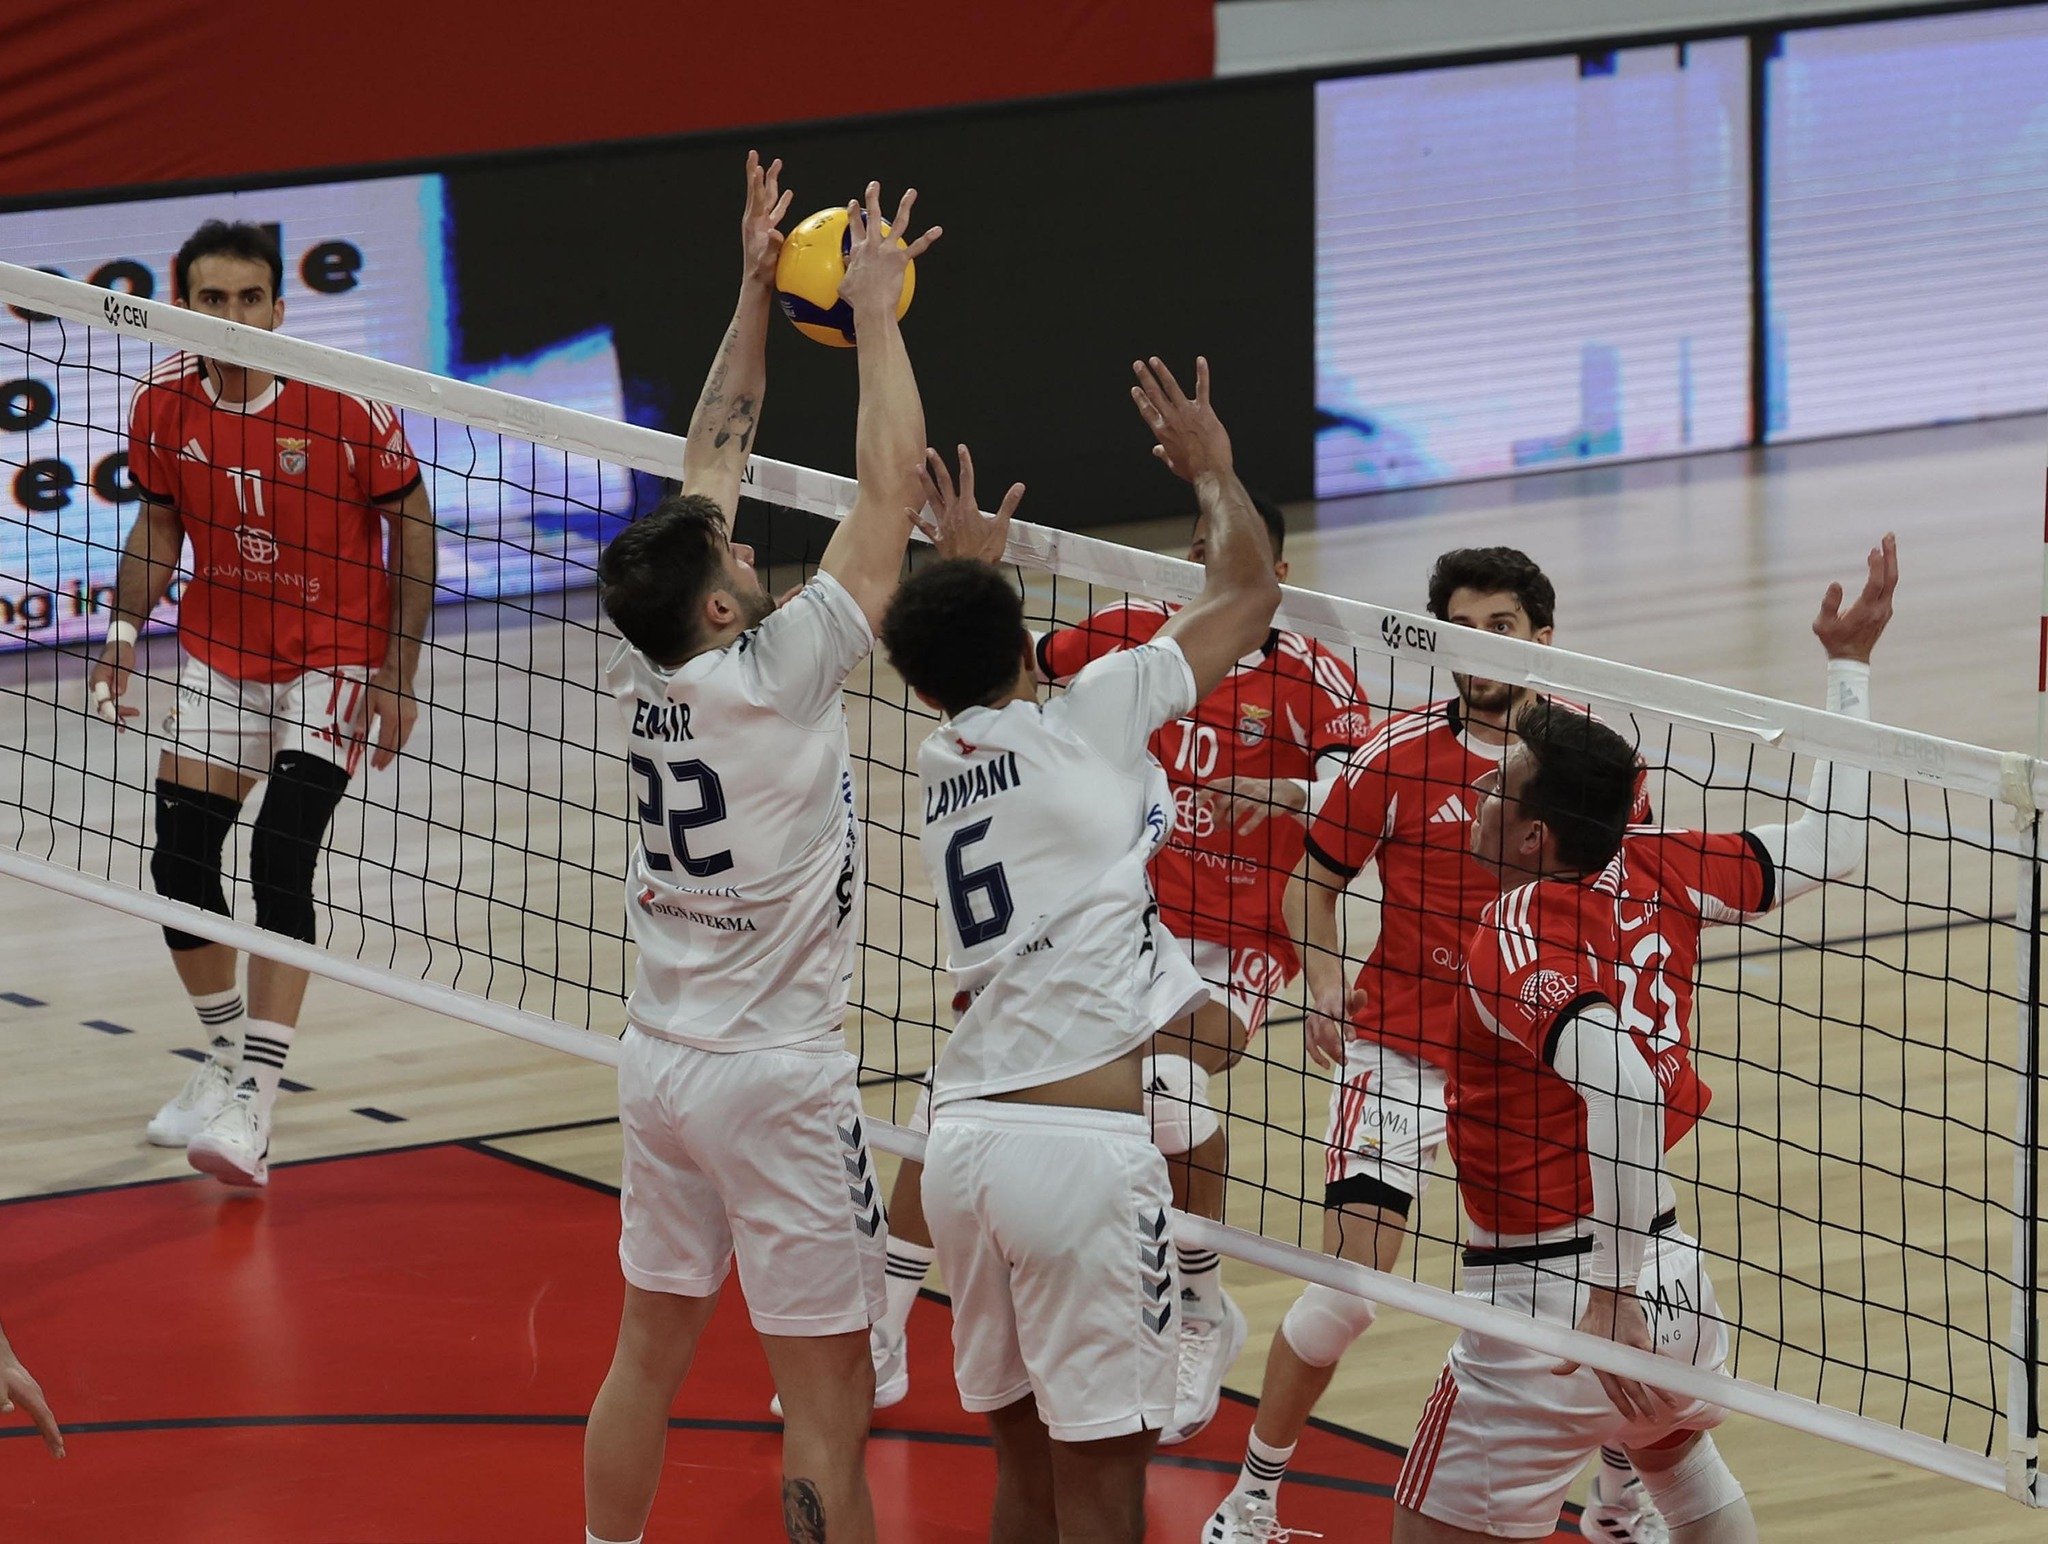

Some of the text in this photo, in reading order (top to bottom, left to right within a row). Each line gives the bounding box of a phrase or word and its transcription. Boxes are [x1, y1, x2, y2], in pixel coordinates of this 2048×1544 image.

[122, 304, 148, 329] CEV
[226, 466, 266, 516] 11
[203, 564, 321, 593] QUADRANTIS
[1405, 625, 1437, 652] CEV
[1174, 718, 1229, 778] 10
[925, 751, 1021, 825] LAWANI
[631, 751, 735, 878] 22
[1167, 836, 1258, 873] DRANTIS
[945, 816, 1015, 949] 6
[652, 902, 757, 932] SIGNATEKMA
[1362, 1106, 1408, 1136] NOMA
[1641, 1279, 1694, 1323] MA
